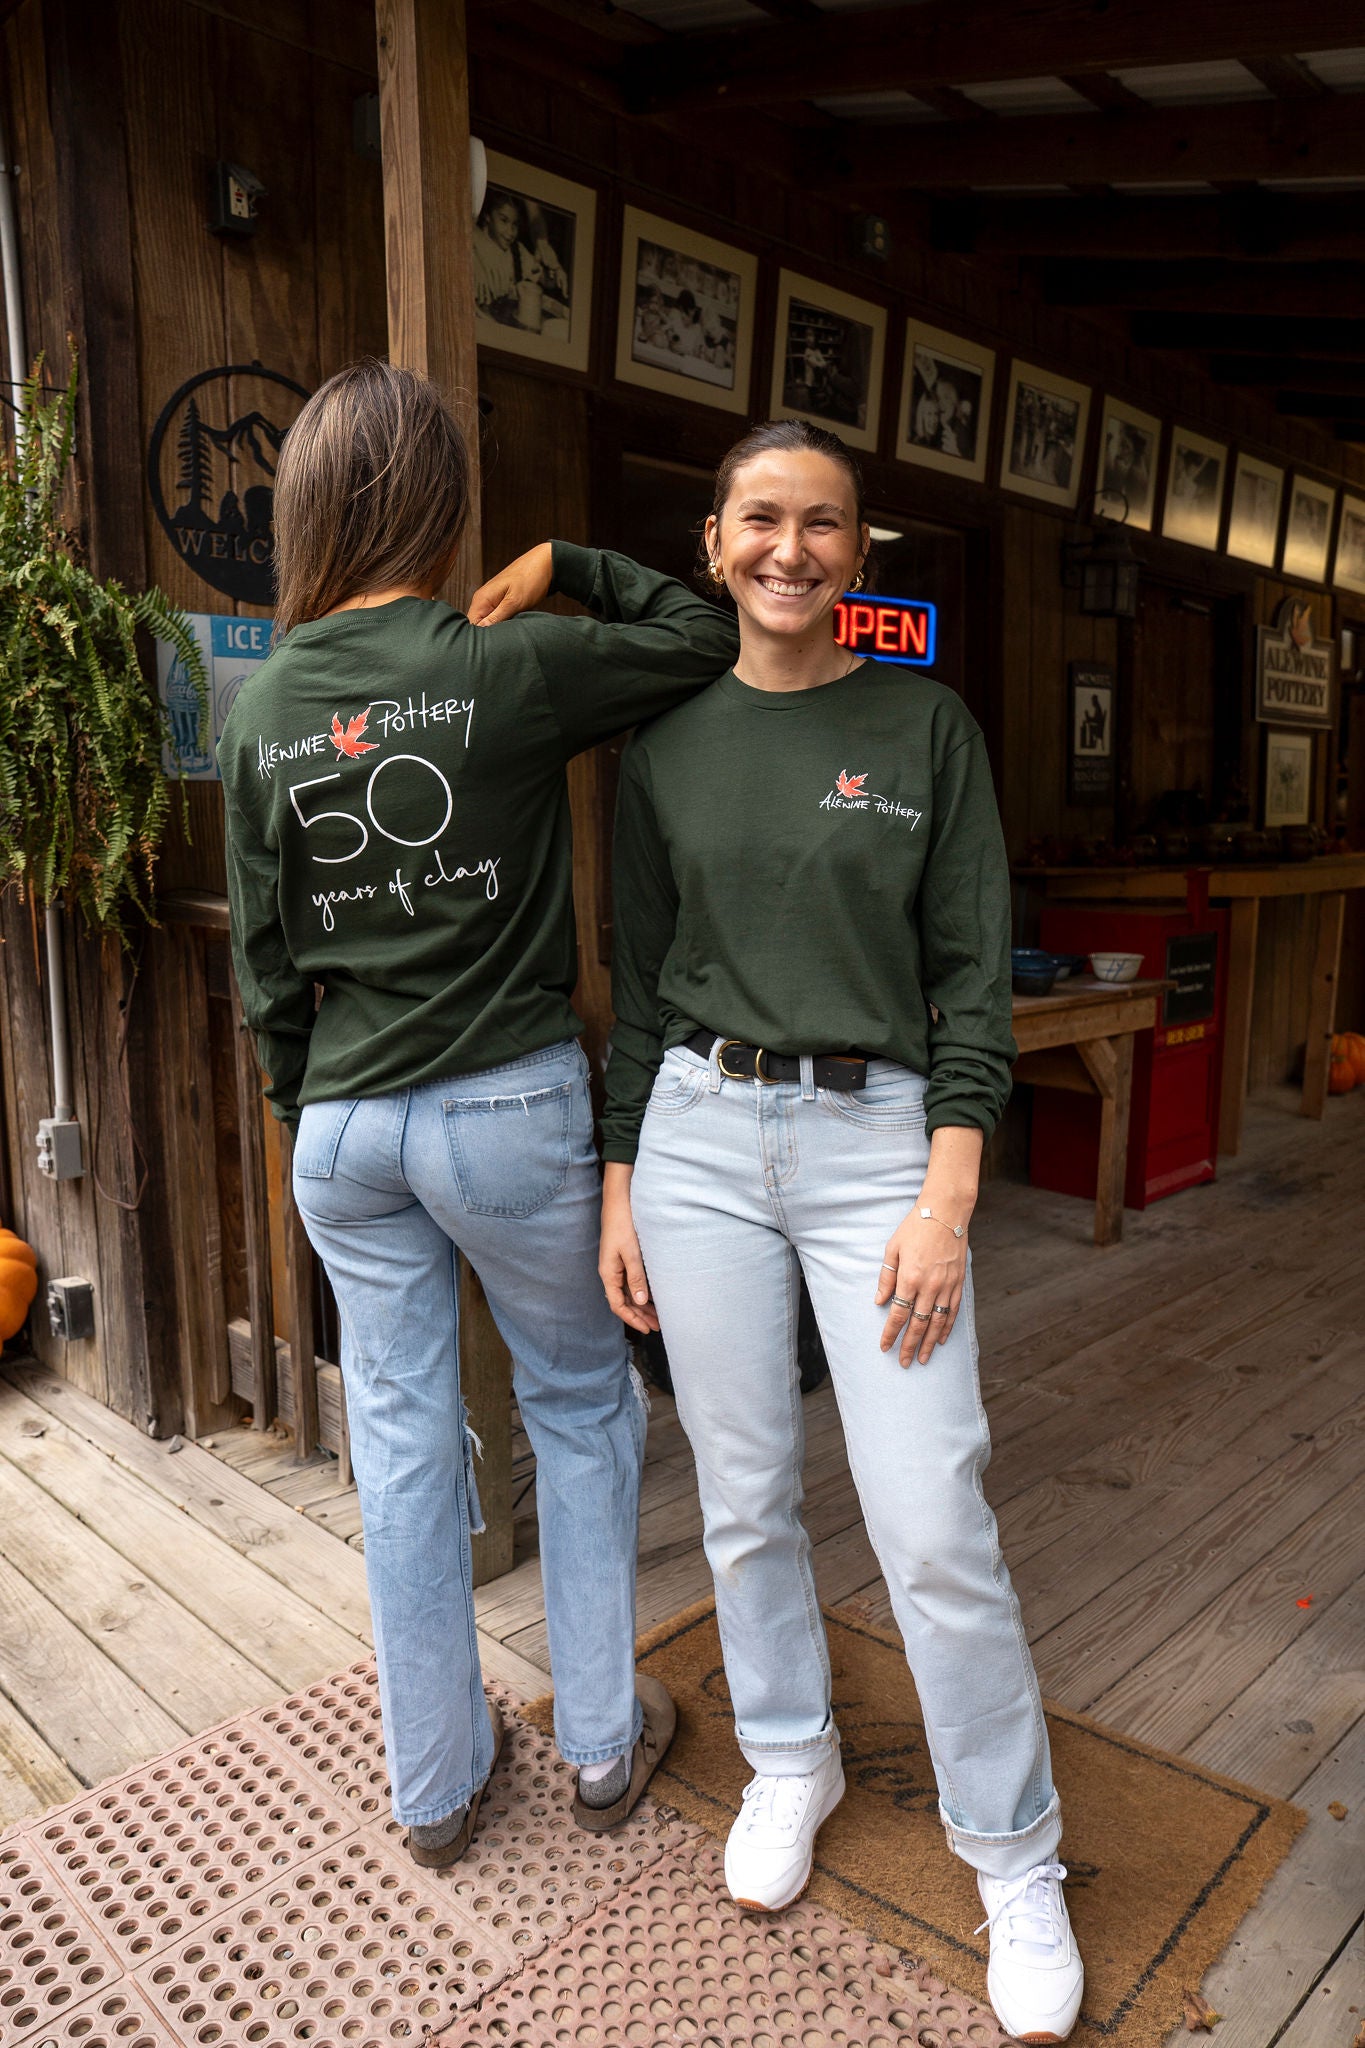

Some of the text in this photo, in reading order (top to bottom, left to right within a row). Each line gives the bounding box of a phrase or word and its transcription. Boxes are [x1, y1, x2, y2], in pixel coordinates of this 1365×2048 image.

[175, 527, 270, 565] WELC
[227, 624, 263, 650] ICE
[1266, 647, 1327, 678] ALEWINE
[1267, 677, 1325, 707] POTTERY
[289, 754, 453, 864] 50
[312, 849, 502, 932] years of clay
